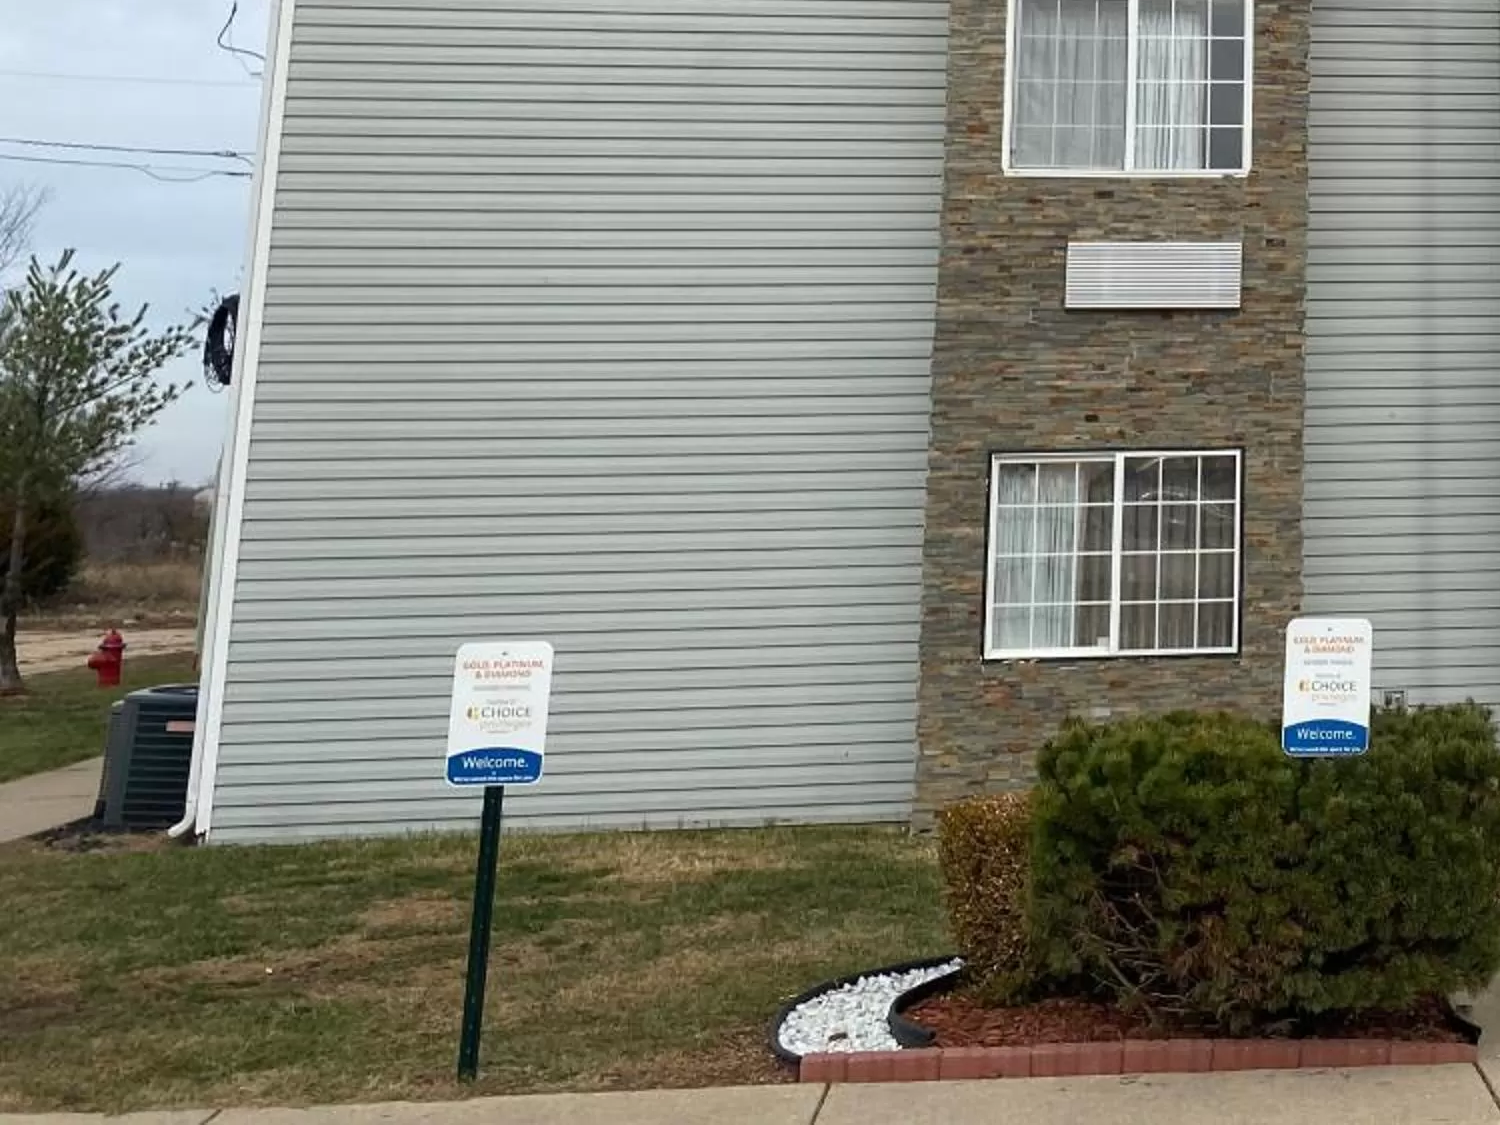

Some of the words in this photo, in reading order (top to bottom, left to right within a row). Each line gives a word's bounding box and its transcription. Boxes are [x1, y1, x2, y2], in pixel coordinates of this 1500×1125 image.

[1311, 680, 1357, 692] CHOICE
[481, 706, 532, 718] CHOICE
[462, 756, 529, 769] Welcome.
